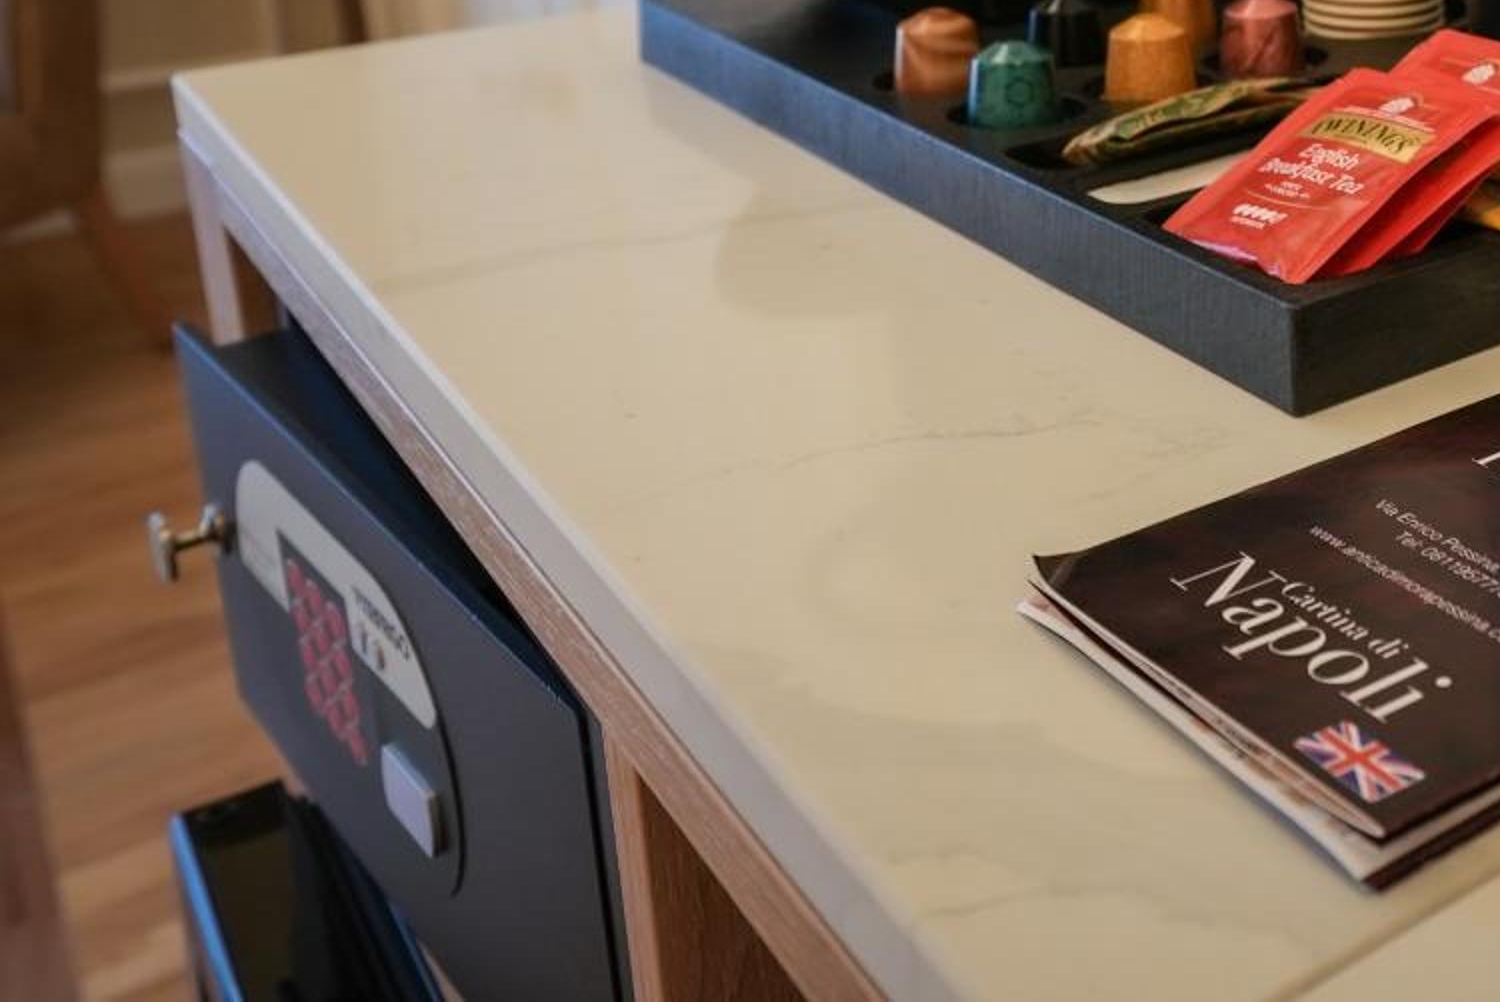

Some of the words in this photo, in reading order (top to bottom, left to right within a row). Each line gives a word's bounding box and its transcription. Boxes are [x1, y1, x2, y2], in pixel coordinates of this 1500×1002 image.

[1376, 499, 1399, 517] Via
[1399, 512, 1443, 541] Enrico
[1169, 550, 1453, 724] Napoli
[1281, 581, 1369, 641] Cartina
[1368, 637, 1410, 659] di
